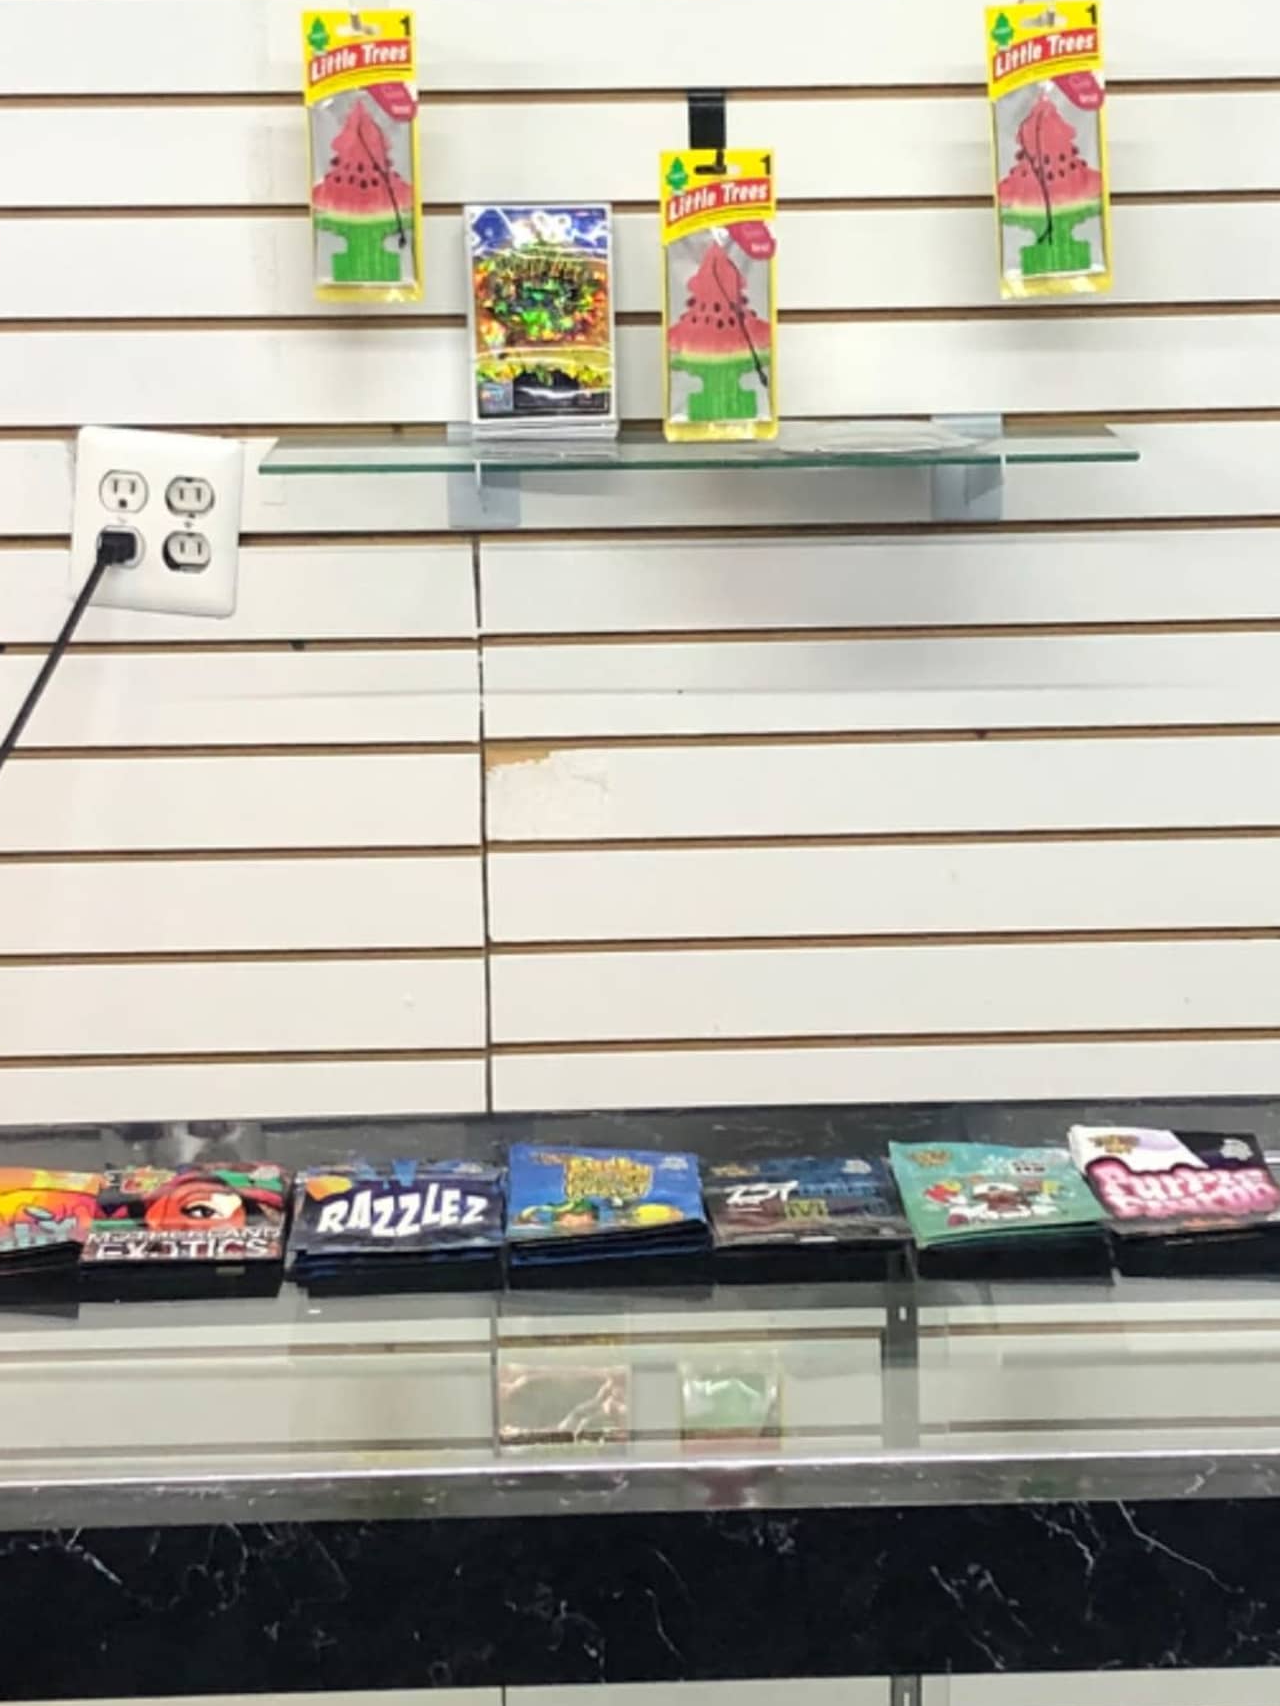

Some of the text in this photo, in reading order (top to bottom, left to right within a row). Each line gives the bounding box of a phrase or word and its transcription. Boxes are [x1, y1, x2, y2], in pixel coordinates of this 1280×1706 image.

[311, 41, 409, 81] Little Trees
[995, 32, 1094, 75] Little Trees
[669, 180, 768, 219] Little Trees
[316, 1182, 489, 1238] RAZZLEZ
[96, 1238, 270, 1260] EXOTICS
